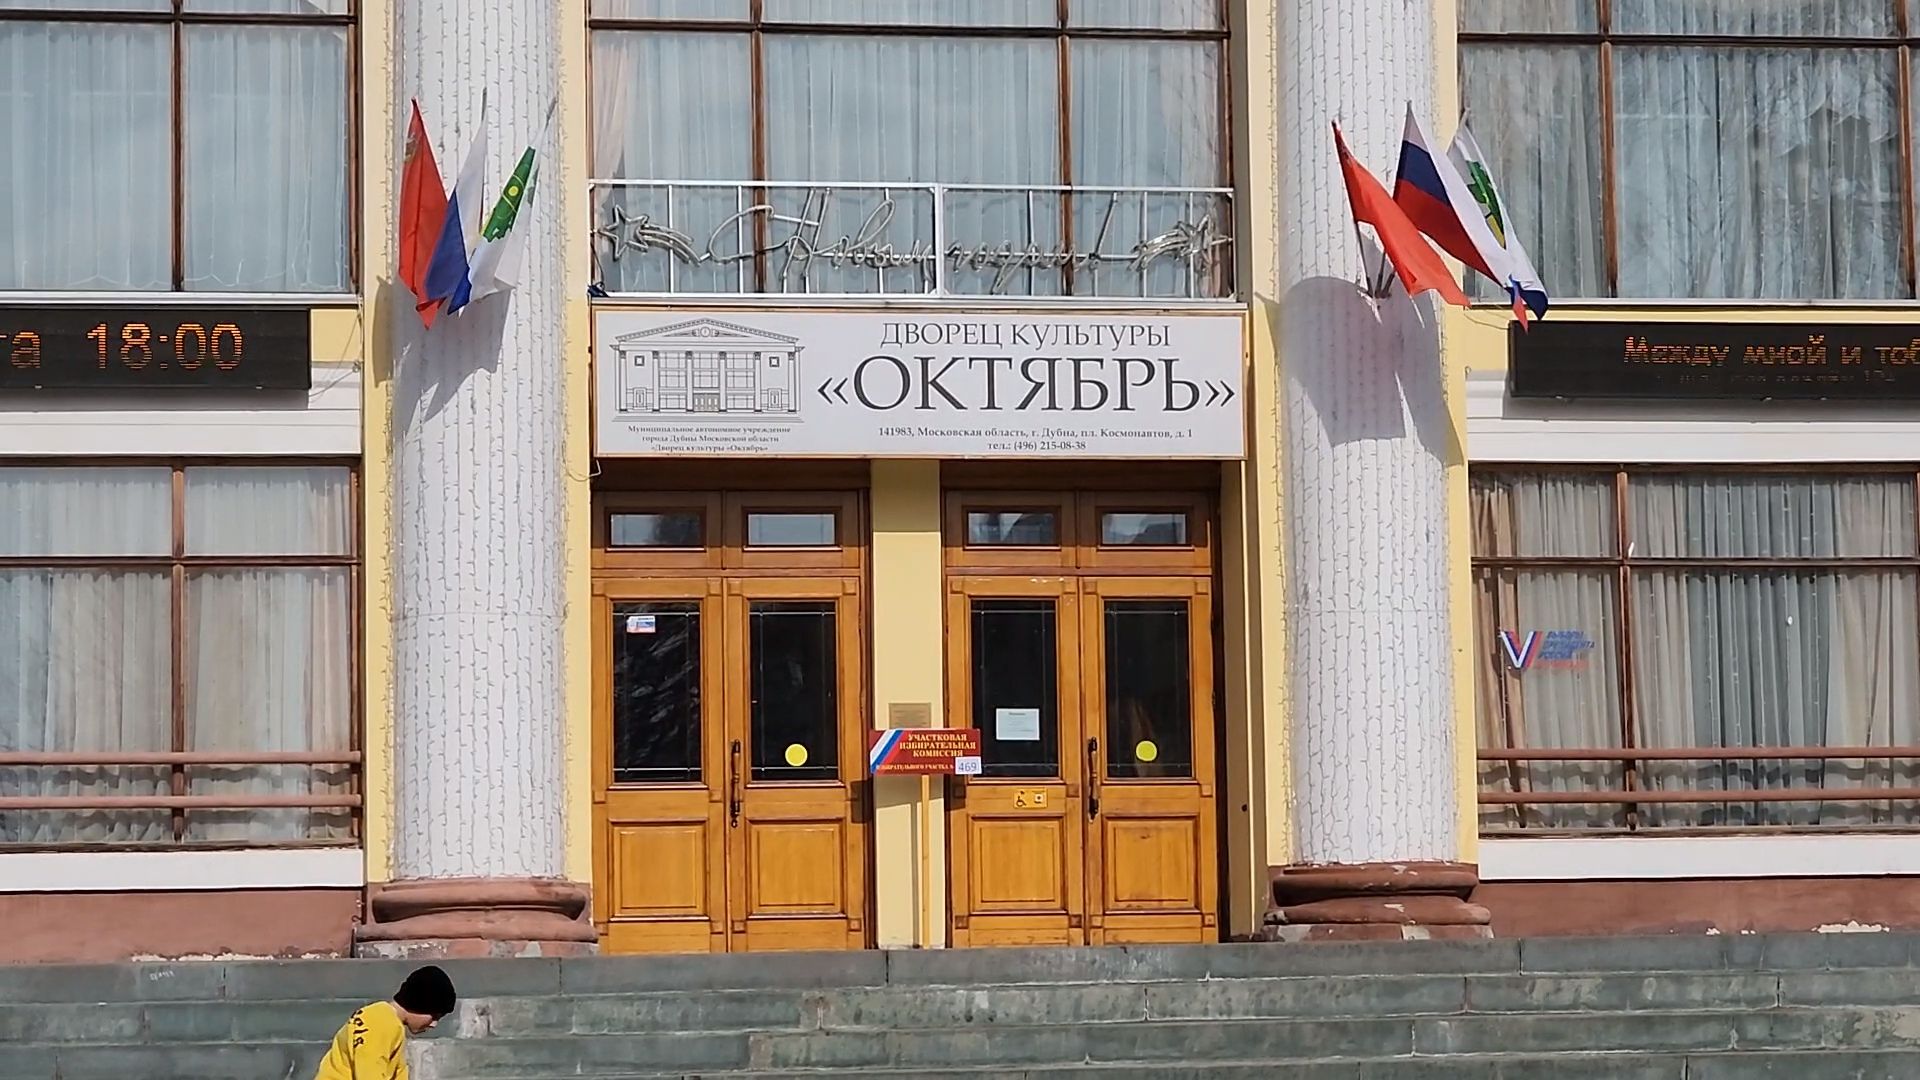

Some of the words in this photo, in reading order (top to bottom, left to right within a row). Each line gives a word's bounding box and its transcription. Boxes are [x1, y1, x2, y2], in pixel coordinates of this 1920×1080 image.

[881, 322, 1004, 348] ДВОРЕЦ
[1011, 323, 1171, 351] КУЛЬТУРЫ
[0, 330, 41, 369] а
[87, 322, 243, 371] 18:00
[1624, 336, 1730, 367] Между
[1743, 334, 1827, 365] мной
[1840, 346, 1861, 365] и
[817, 355, 1235, 412] «ОКТЯБРЬ»
[628, 425, 694, 434] Муниципальное
[695, 426, 741, 434] автономное
[742, 426, 791, 435] учреждение
[879, 428, 914, 438] 141983,
[917, 428, 982, 437] Московская
[984, 427, 1029, 438] область,
[1041, 428, 1078, 439] Дубна,
[1080, 430, 1098, 438] пл.
[1100, 428, 1173, 439] Космонавтов,
[1187, 429, 1193, 438] 1
[642, 436, 669, 444] города
[670, 435, 697, 444] Дубны
[698, 435, 747, 443] Московской
[748, 434, 779, 443] области
[686, 445, 725, 453] культуры
[987, 441, 1011, 450] тел.:
[1013, 440, 1038, 451] (496)
[1040, 441, 1087, 450] 215-08-38
[908, 733, 967, 741] УЧАСТКОВАЯ
[899, 741, 976, 750] ИЗБИРАТЕЛЬНАЯ
[913, 749, 963, 758] КОМИССИЯ
[958, 761, 977, 772] 469
